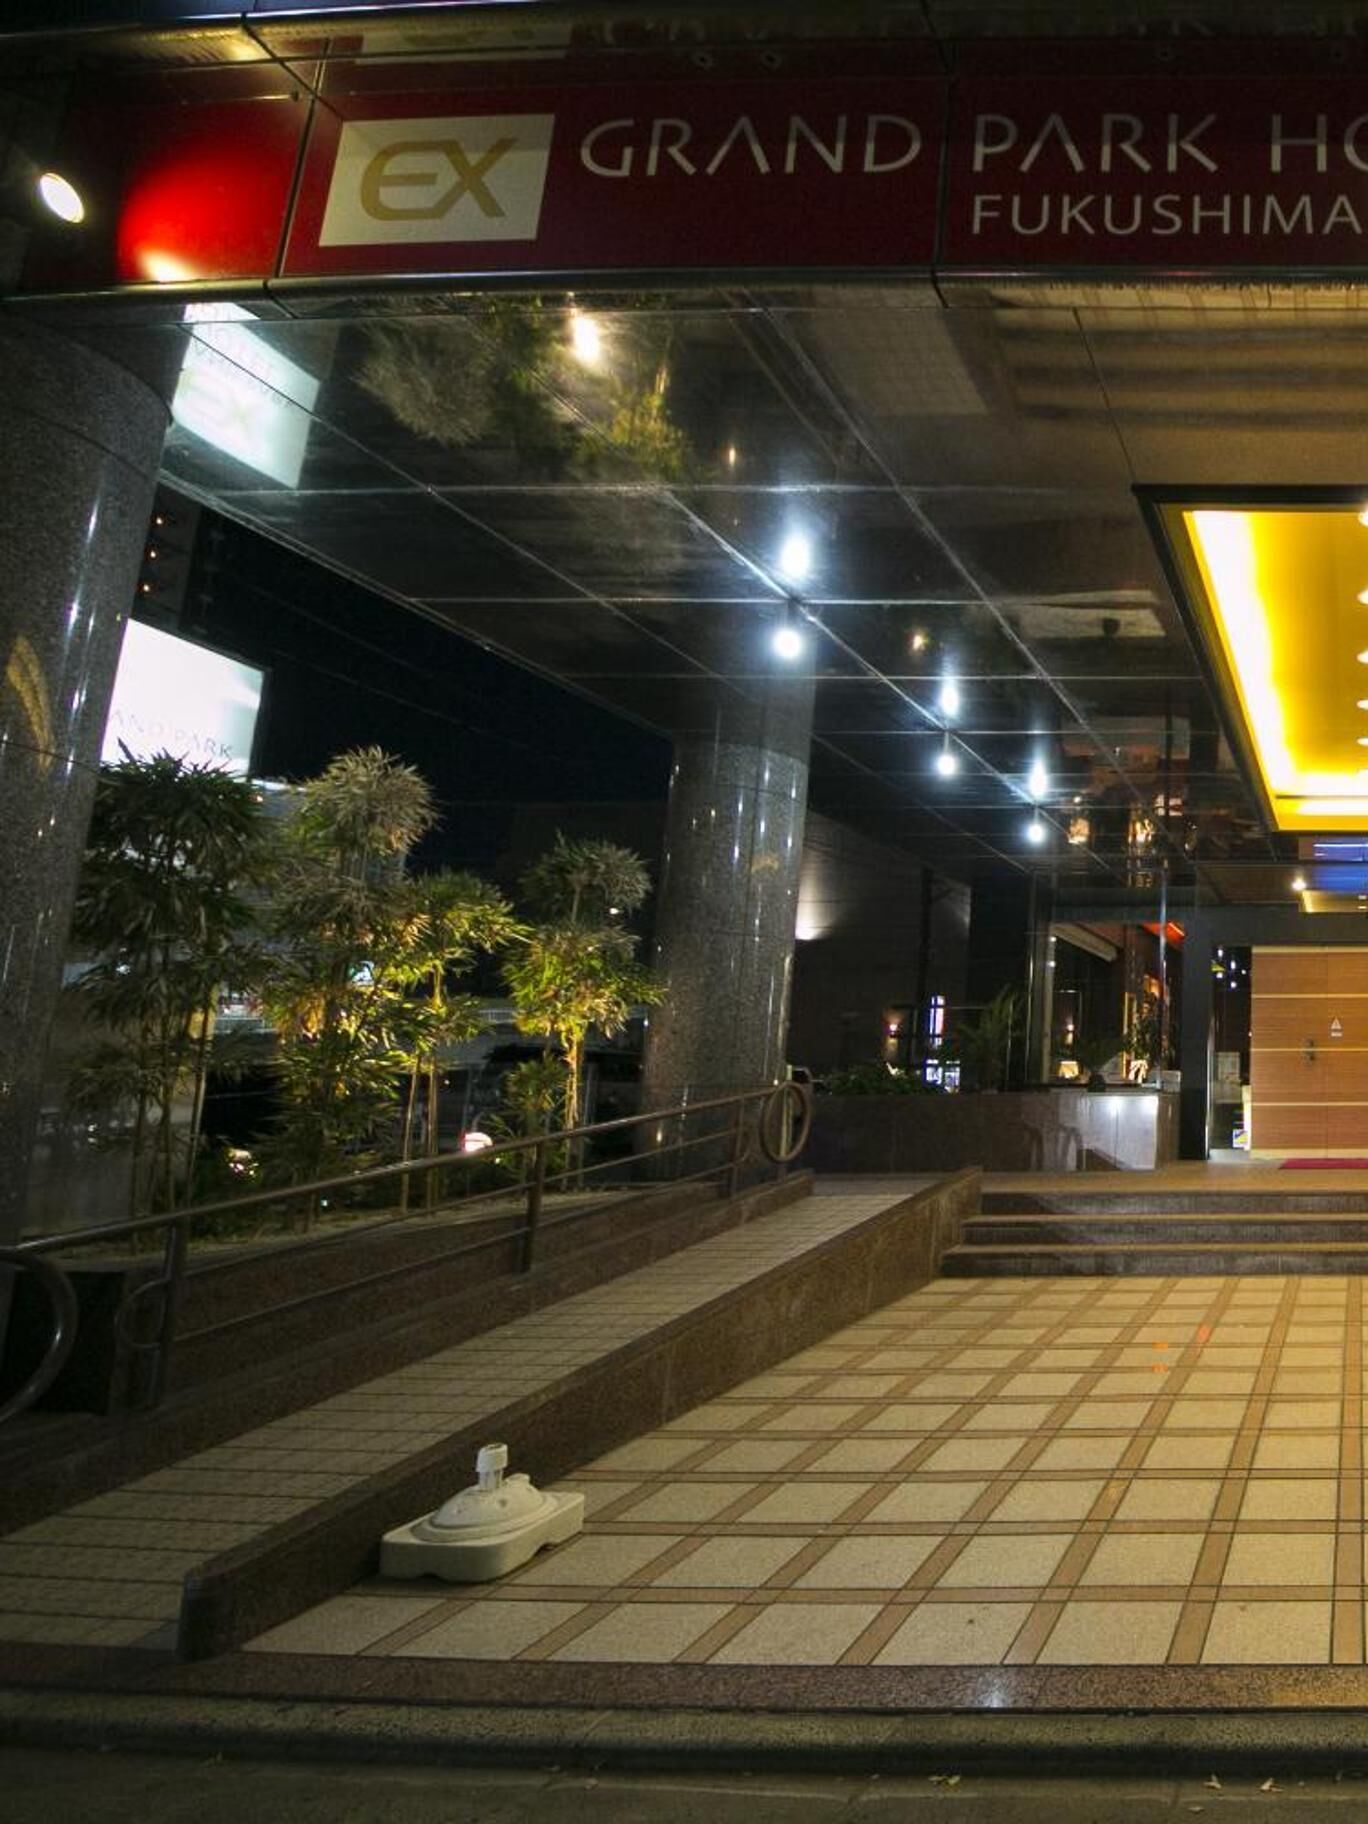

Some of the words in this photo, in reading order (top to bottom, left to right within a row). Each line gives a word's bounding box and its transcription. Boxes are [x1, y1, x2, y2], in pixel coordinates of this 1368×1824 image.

[580, 114, 922, 177] GRAND
[972, 113, 1219, 173] PARK
[360, 137, 518, 221] EX
[972, 195, 1363, 235] FUKUSHIMA
